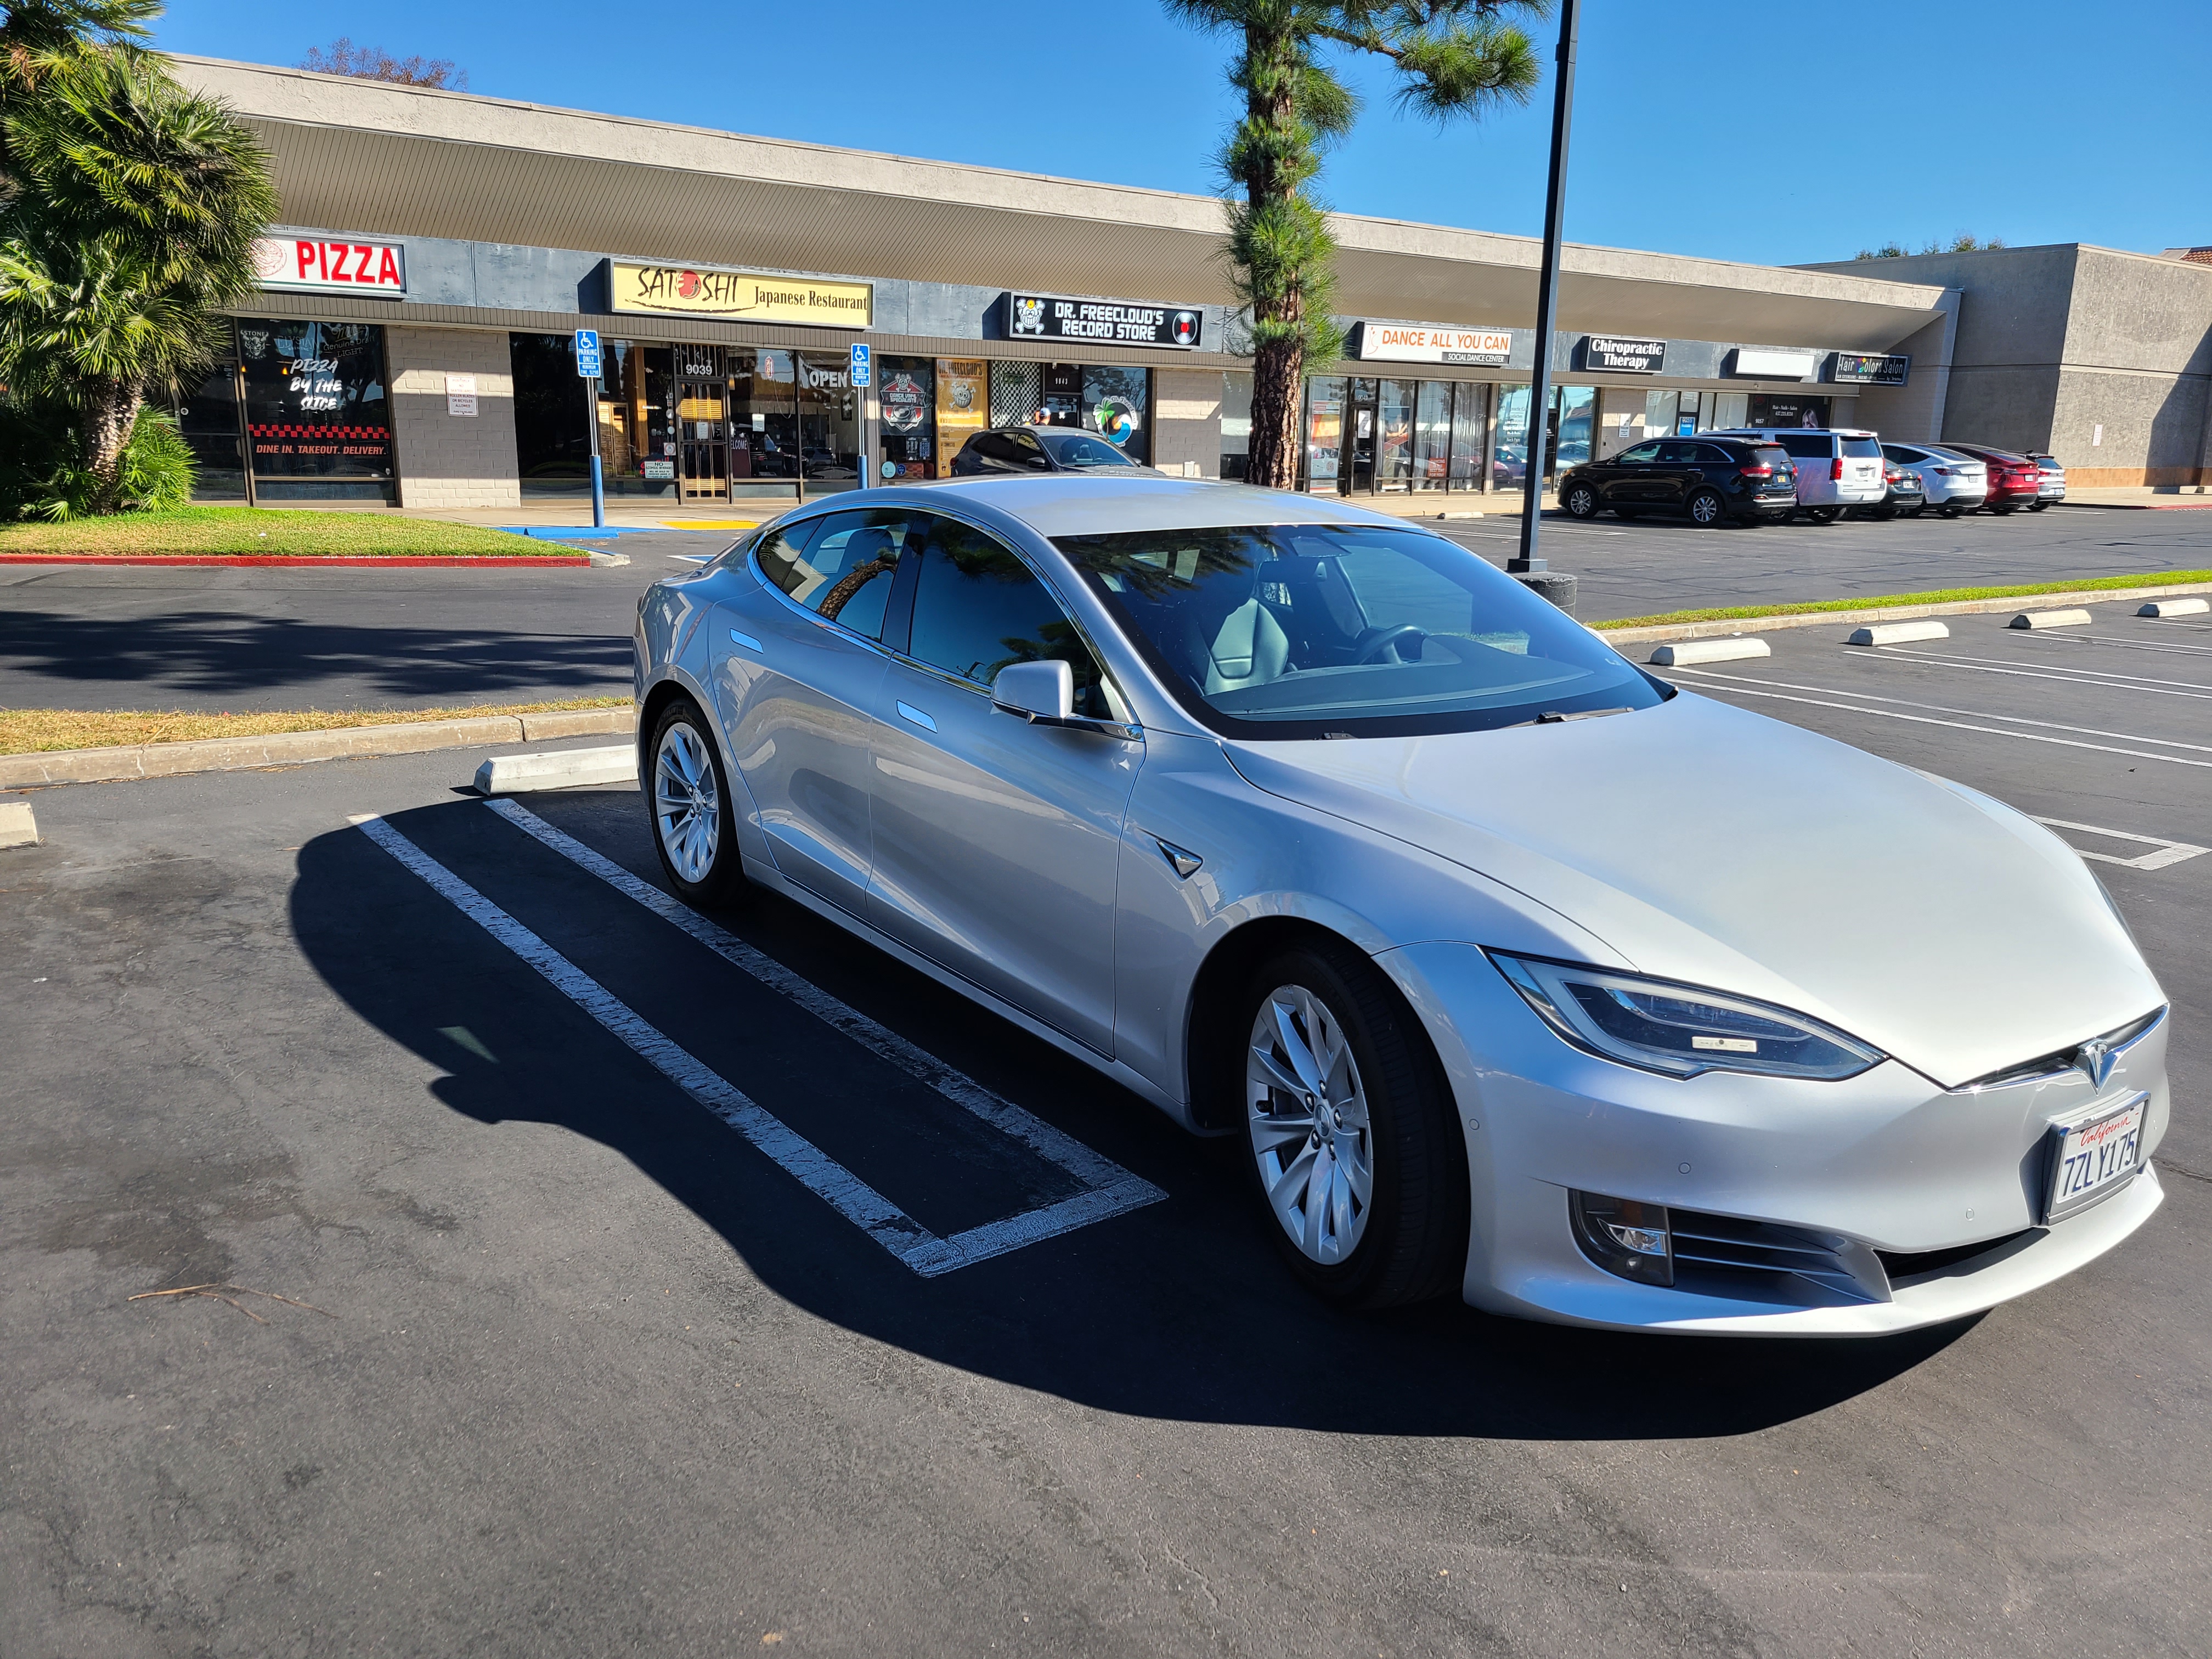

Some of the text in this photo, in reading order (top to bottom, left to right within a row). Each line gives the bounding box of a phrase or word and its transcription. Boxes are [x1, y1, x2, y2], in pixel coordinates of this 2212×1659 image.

[296, 241, 400, 285] PIZZA
[637, 267, 738, 304] SATOSHI
[754, 286, 868, 311] Japanese Restaurant
[1054, 302, 1164, 325] DR. FREECLOUD'S
[1062, 319, 1156, 341] RECORD STORE
[277, 335, 319, 349] ELYSIAN
[324, 340, 354, 351] Genuine
[1382, 330, 1508, 350] DANCE ALL YOU CAN
[1592, 339, 1663, 356] Chiropractic
[337, 347, 363, 358] LIGHT
[1448, 353, 1504, 363] SOCIAL DANCE CENTER
[290, 358, 338, 374] PIZZA
[686, 364, 713, 375] 9039
[938, 361, 982, 376] DR. FREECLOUD'S
[1604, 353, 1650, 370] Therapy
[1837, 355, 1854, 372] Hair
[1883, 358, 1903, 374] Salon
[290, 377, 342, 393] BY THE
[809, 371, 847, 387] OPEN
[301, 397, 338, 411] SLICE
[256, 445, 386, 455] DINE IN. TAKEOUT. DELIVERY.
[731, 439, 747, 450] ELCOME
[2080, 1116, 2131, 1147] California
[2063, 1127, 2137, 1197] 7ZLY175
